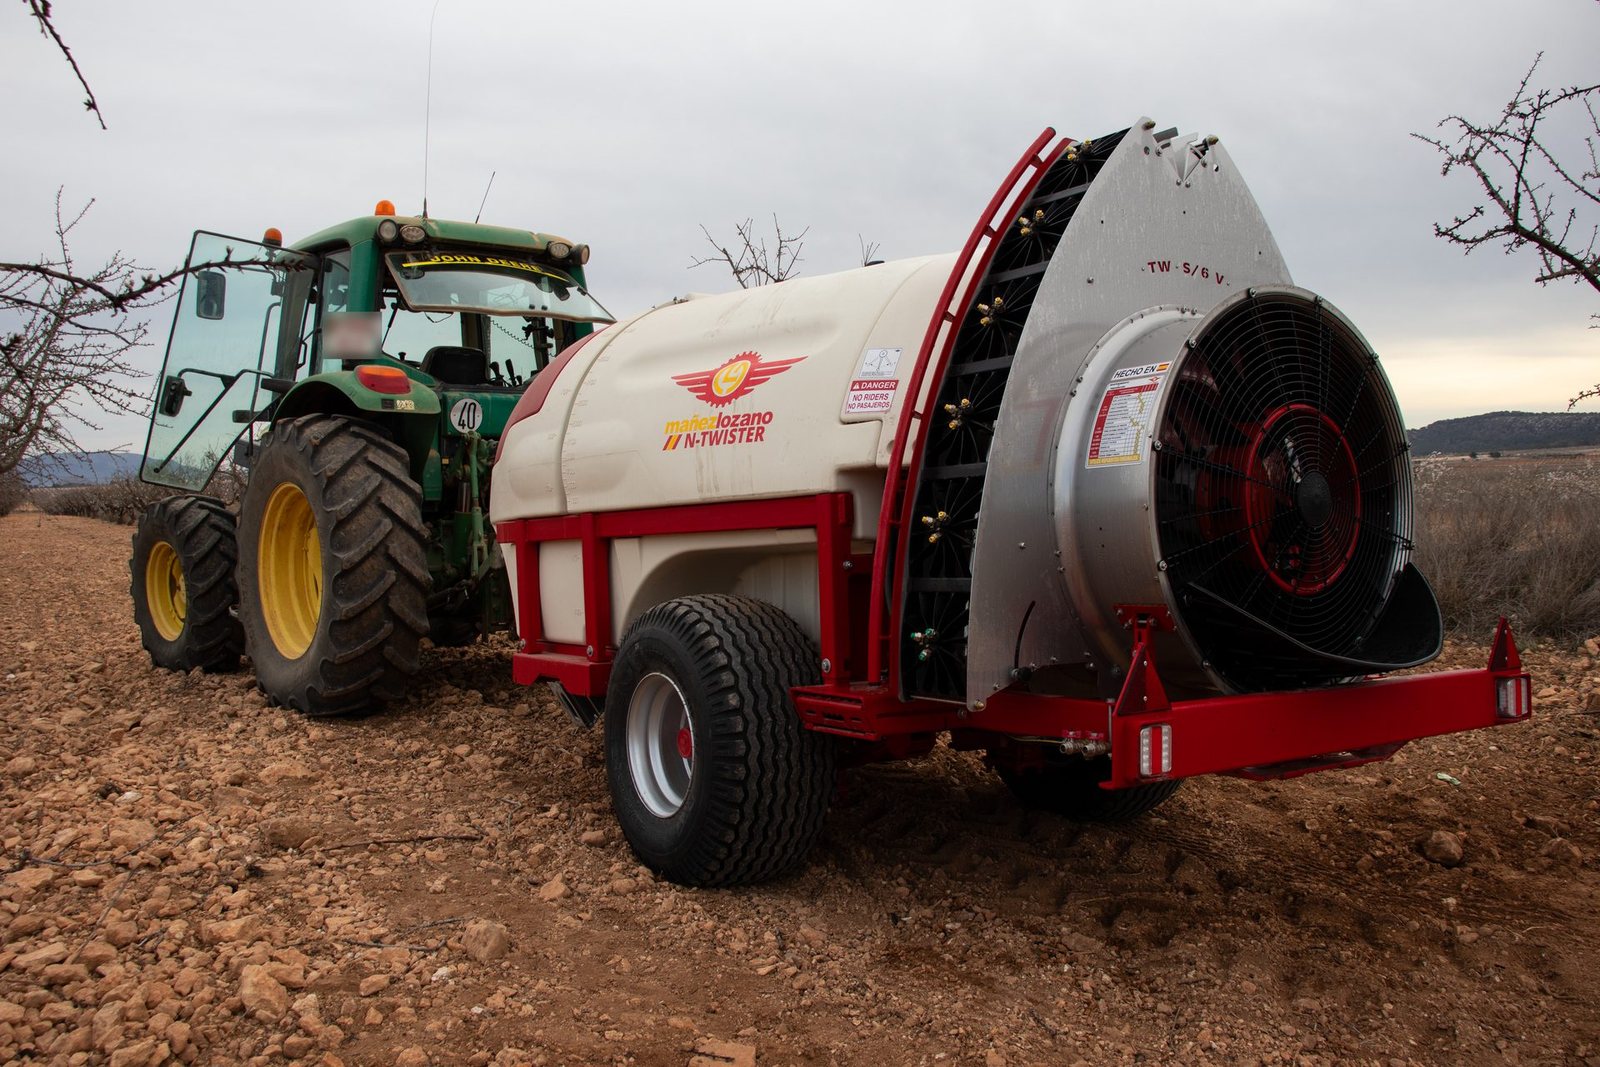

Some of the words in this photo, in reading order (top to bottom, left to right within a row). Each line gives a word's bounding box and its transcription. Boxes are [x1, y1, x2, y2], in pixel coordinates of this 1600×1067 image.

[430, 255, 480, 263] JOHN
[485, 257, 543, 272] DEERE
[1147, 260, 1171, 273] TW
[1183, 262, 1209, 279] S/6
[1113, 367, 1144, 379] HECHO
[1144, 364, 1157, 373] EN
[861, 381, 896, 389] DANGER
[853, 394, 863, 402] NO
[864, 393, 889, 401] RIDERS
[857, 401, 890, 409] PASAJEROS
[458, 401, 477, 430] 40
[684, 426, 766, 448] N-TWISTER
